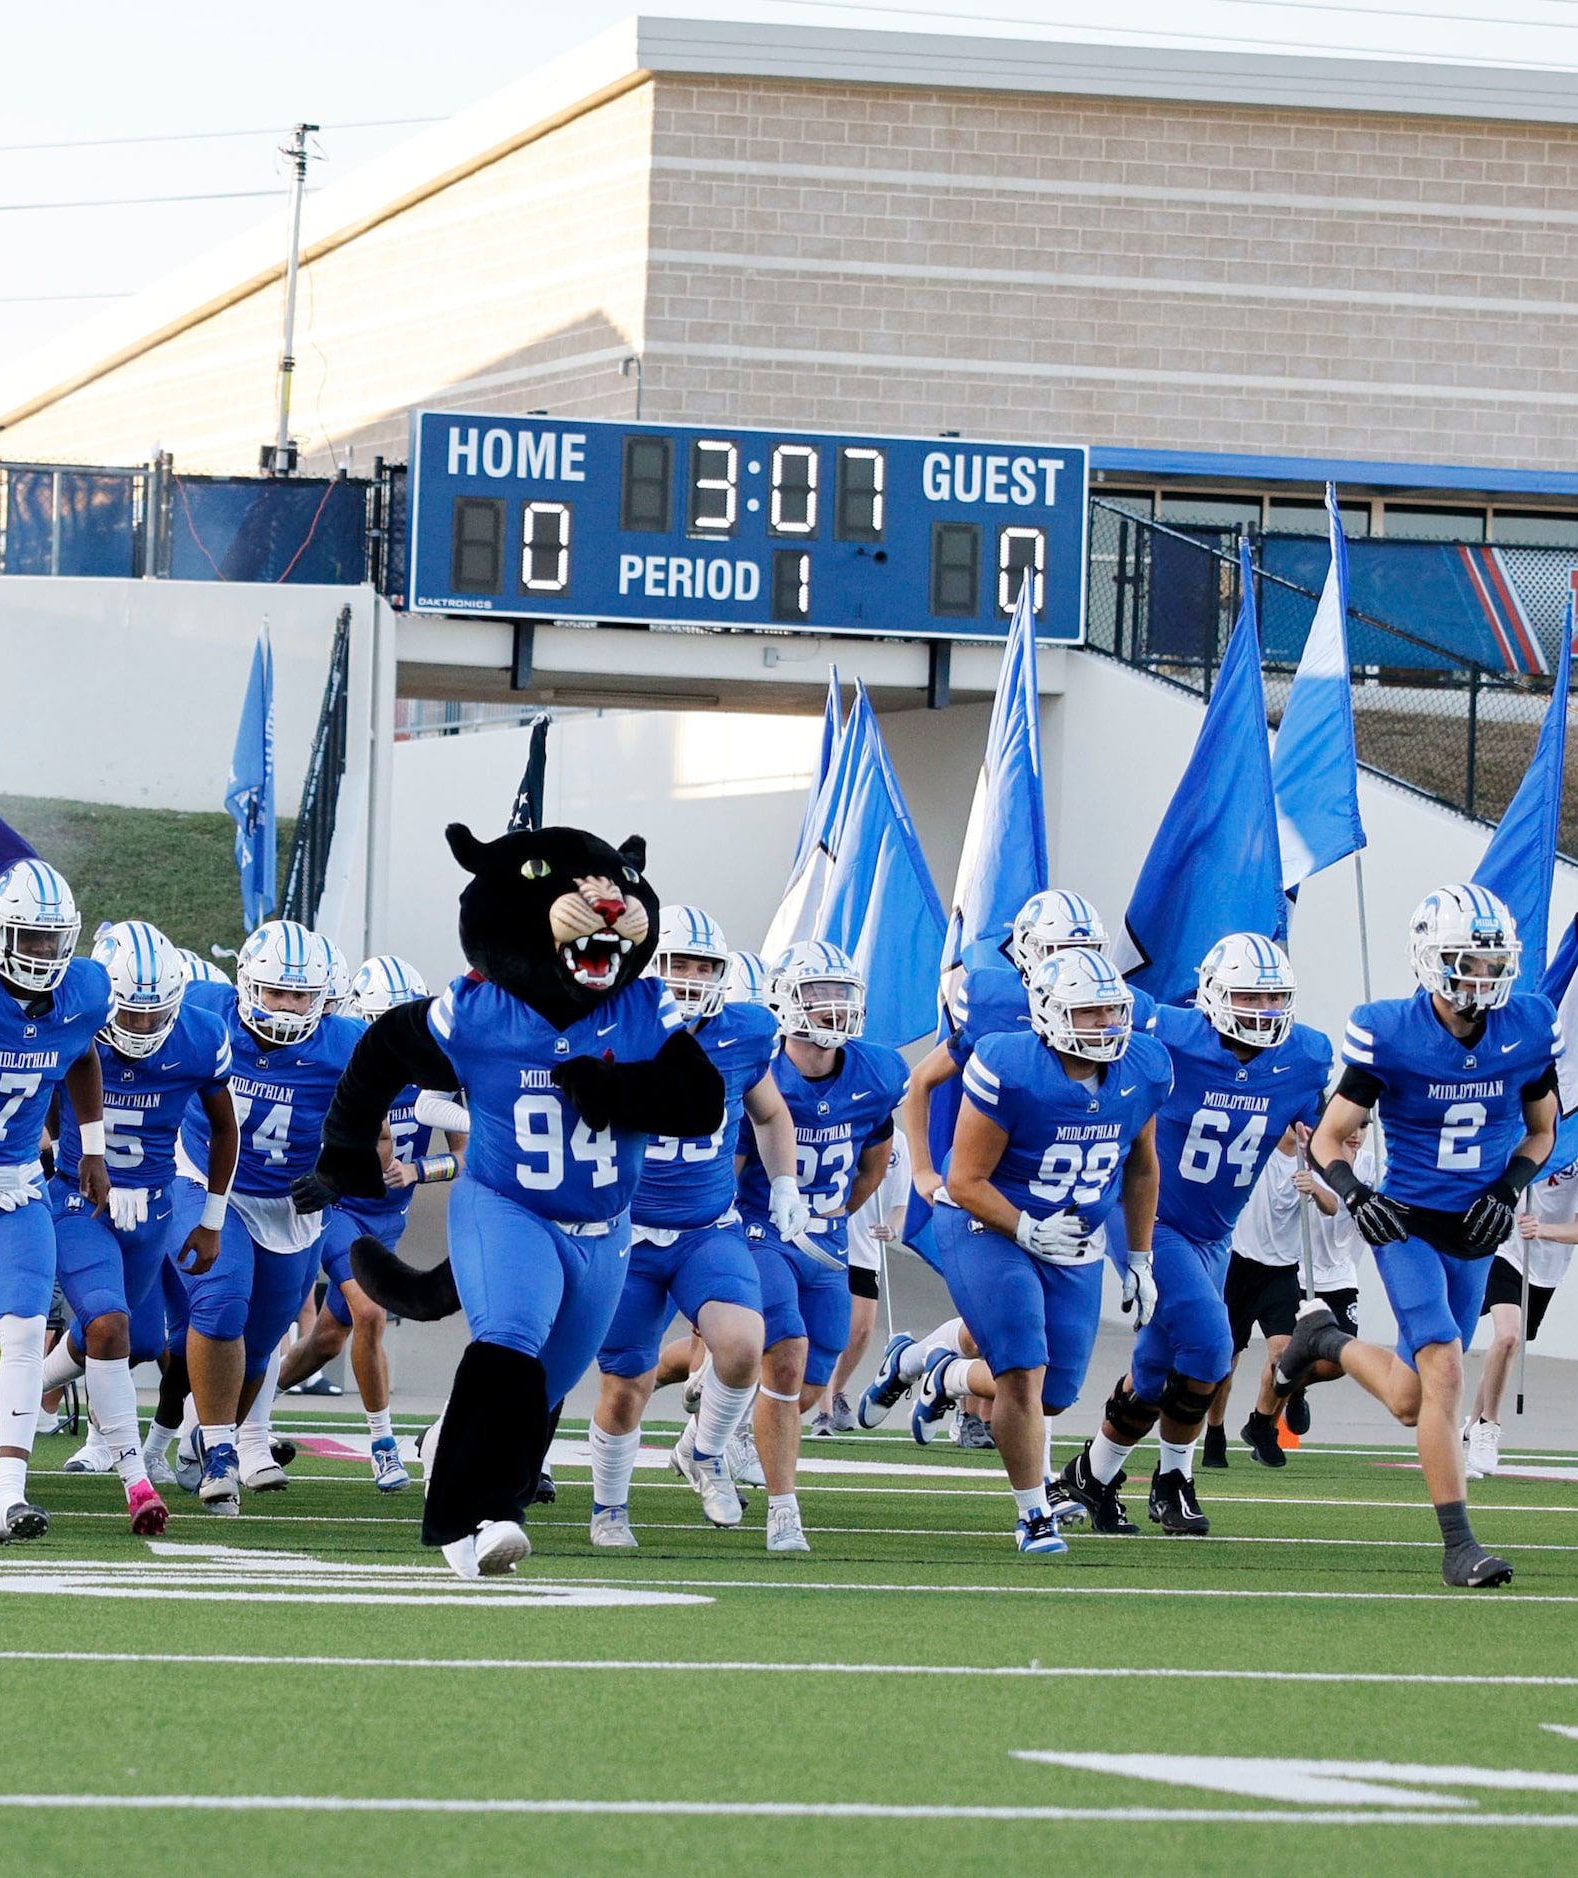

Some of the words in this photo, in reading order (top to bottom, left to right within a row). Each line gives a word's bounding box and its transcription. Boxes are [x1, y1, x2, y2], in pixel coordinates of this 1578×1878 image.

[447, 426, 588, 482] HOME
[694, 439, 884, 533] 3:07
[922, 451, 1065, 507] GUEST
[521, 501, 570, 591] 0
[998, 526, 1045, 614] 0
[618, 553, 760, 602] PERIOD
[797, 554, 810, 613] 1
[1202, 1090, 1271, 1113] MIDLOTHIAN
[1427, 1079, 1504, 1100] MIDLOTHIAN
[102, 1107, 144, 1169] 5
[235, 1096, 294, 1167] 74
[513, 1094, 618, 1191] 94
[1055, 1123, 1122, 1141] MIDLOTHIAN
[1178, 1107, 1269, 1188] 64
[1436, 1101, 1488, 1169] 2
[796, 1140, 855, 1214] 23
[1028, 1141, 1120, 1204] 99
